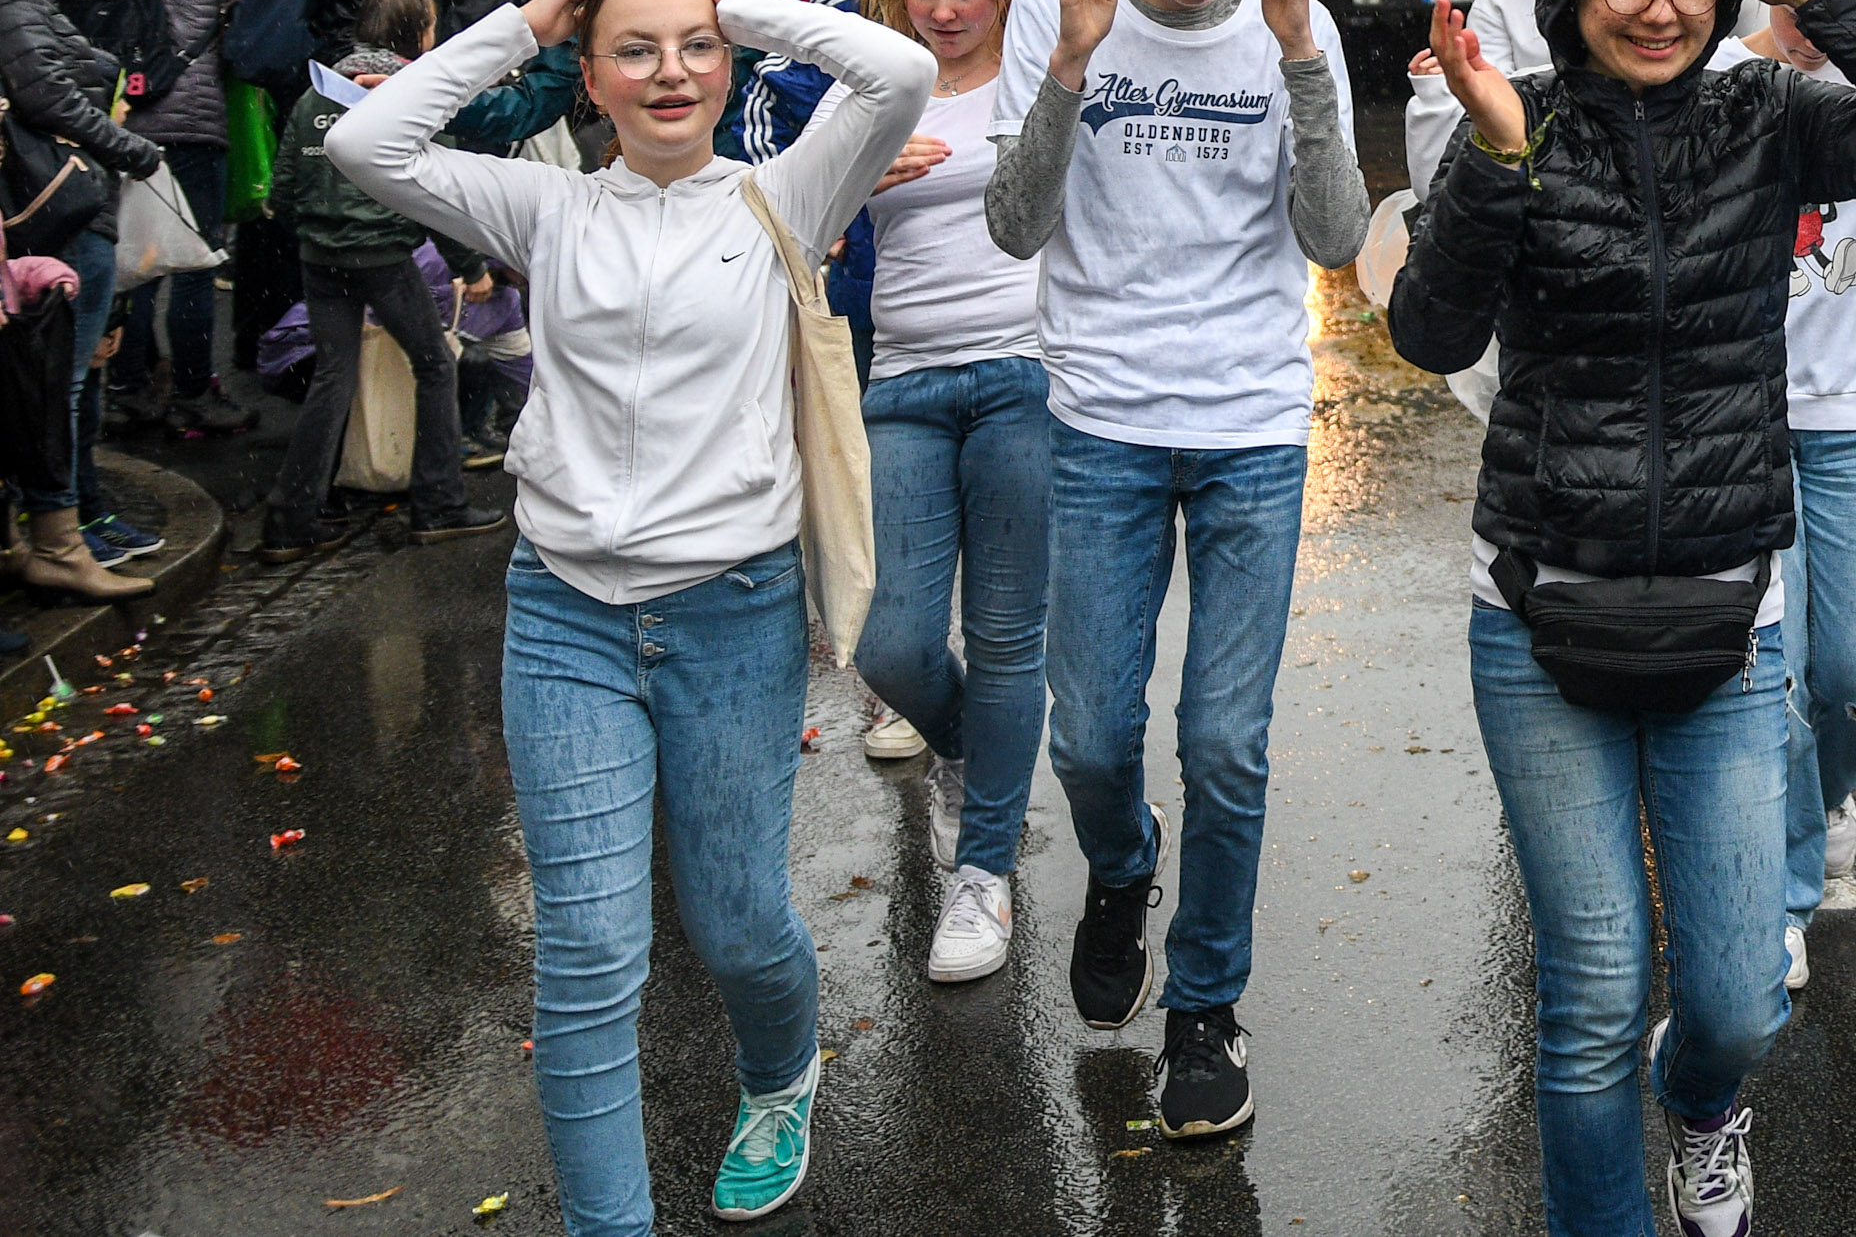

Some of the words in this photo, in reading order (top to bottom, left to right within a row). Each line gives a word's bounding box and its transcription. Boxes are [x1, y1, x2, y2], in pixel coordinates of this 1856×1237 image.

[1084, 72, 1155, 112] Altes
[1155, 78, 1274, 116] Gymnasium
[1124, 123, 1231, 143] OLDENBURG
[1124, 141, 1153, 156] EST
[1196, 146, 1228, 160] 1573
